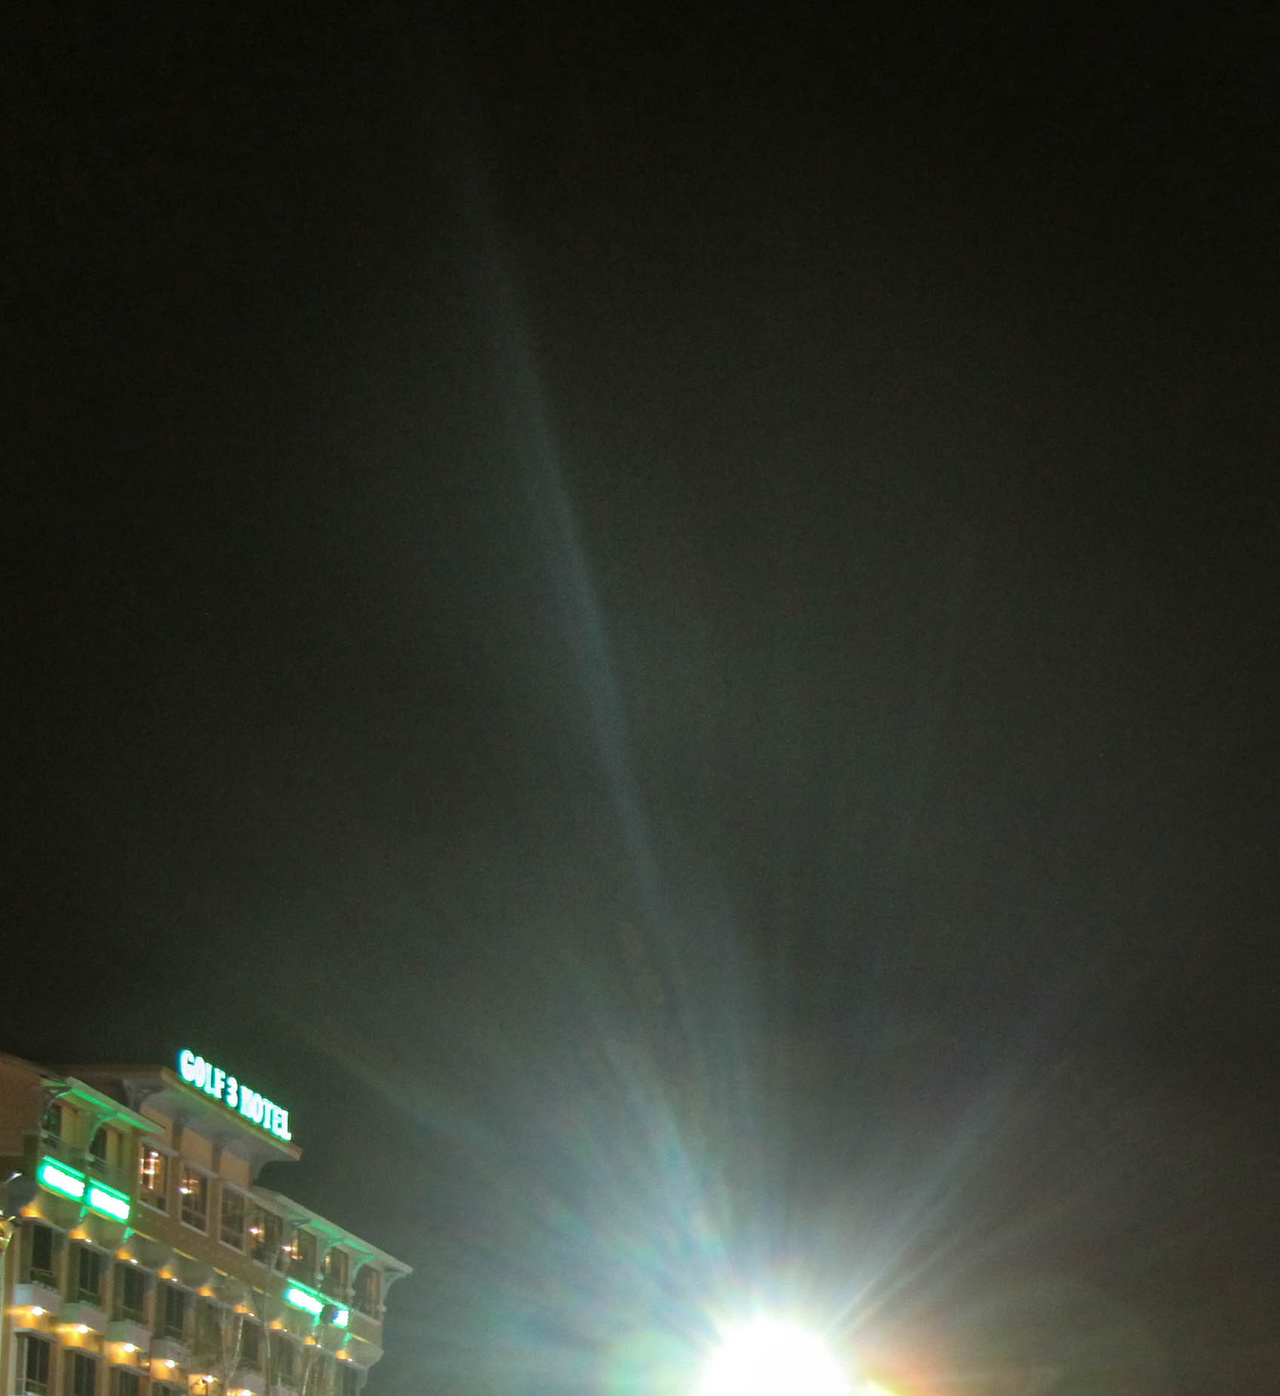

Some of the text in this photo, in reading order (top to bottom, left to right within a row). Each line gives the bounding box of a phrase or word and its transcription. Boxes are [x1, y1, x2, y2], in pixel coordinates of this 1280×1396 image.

[179, 1049, 293, 1142] GOLF 3 HOTEL
